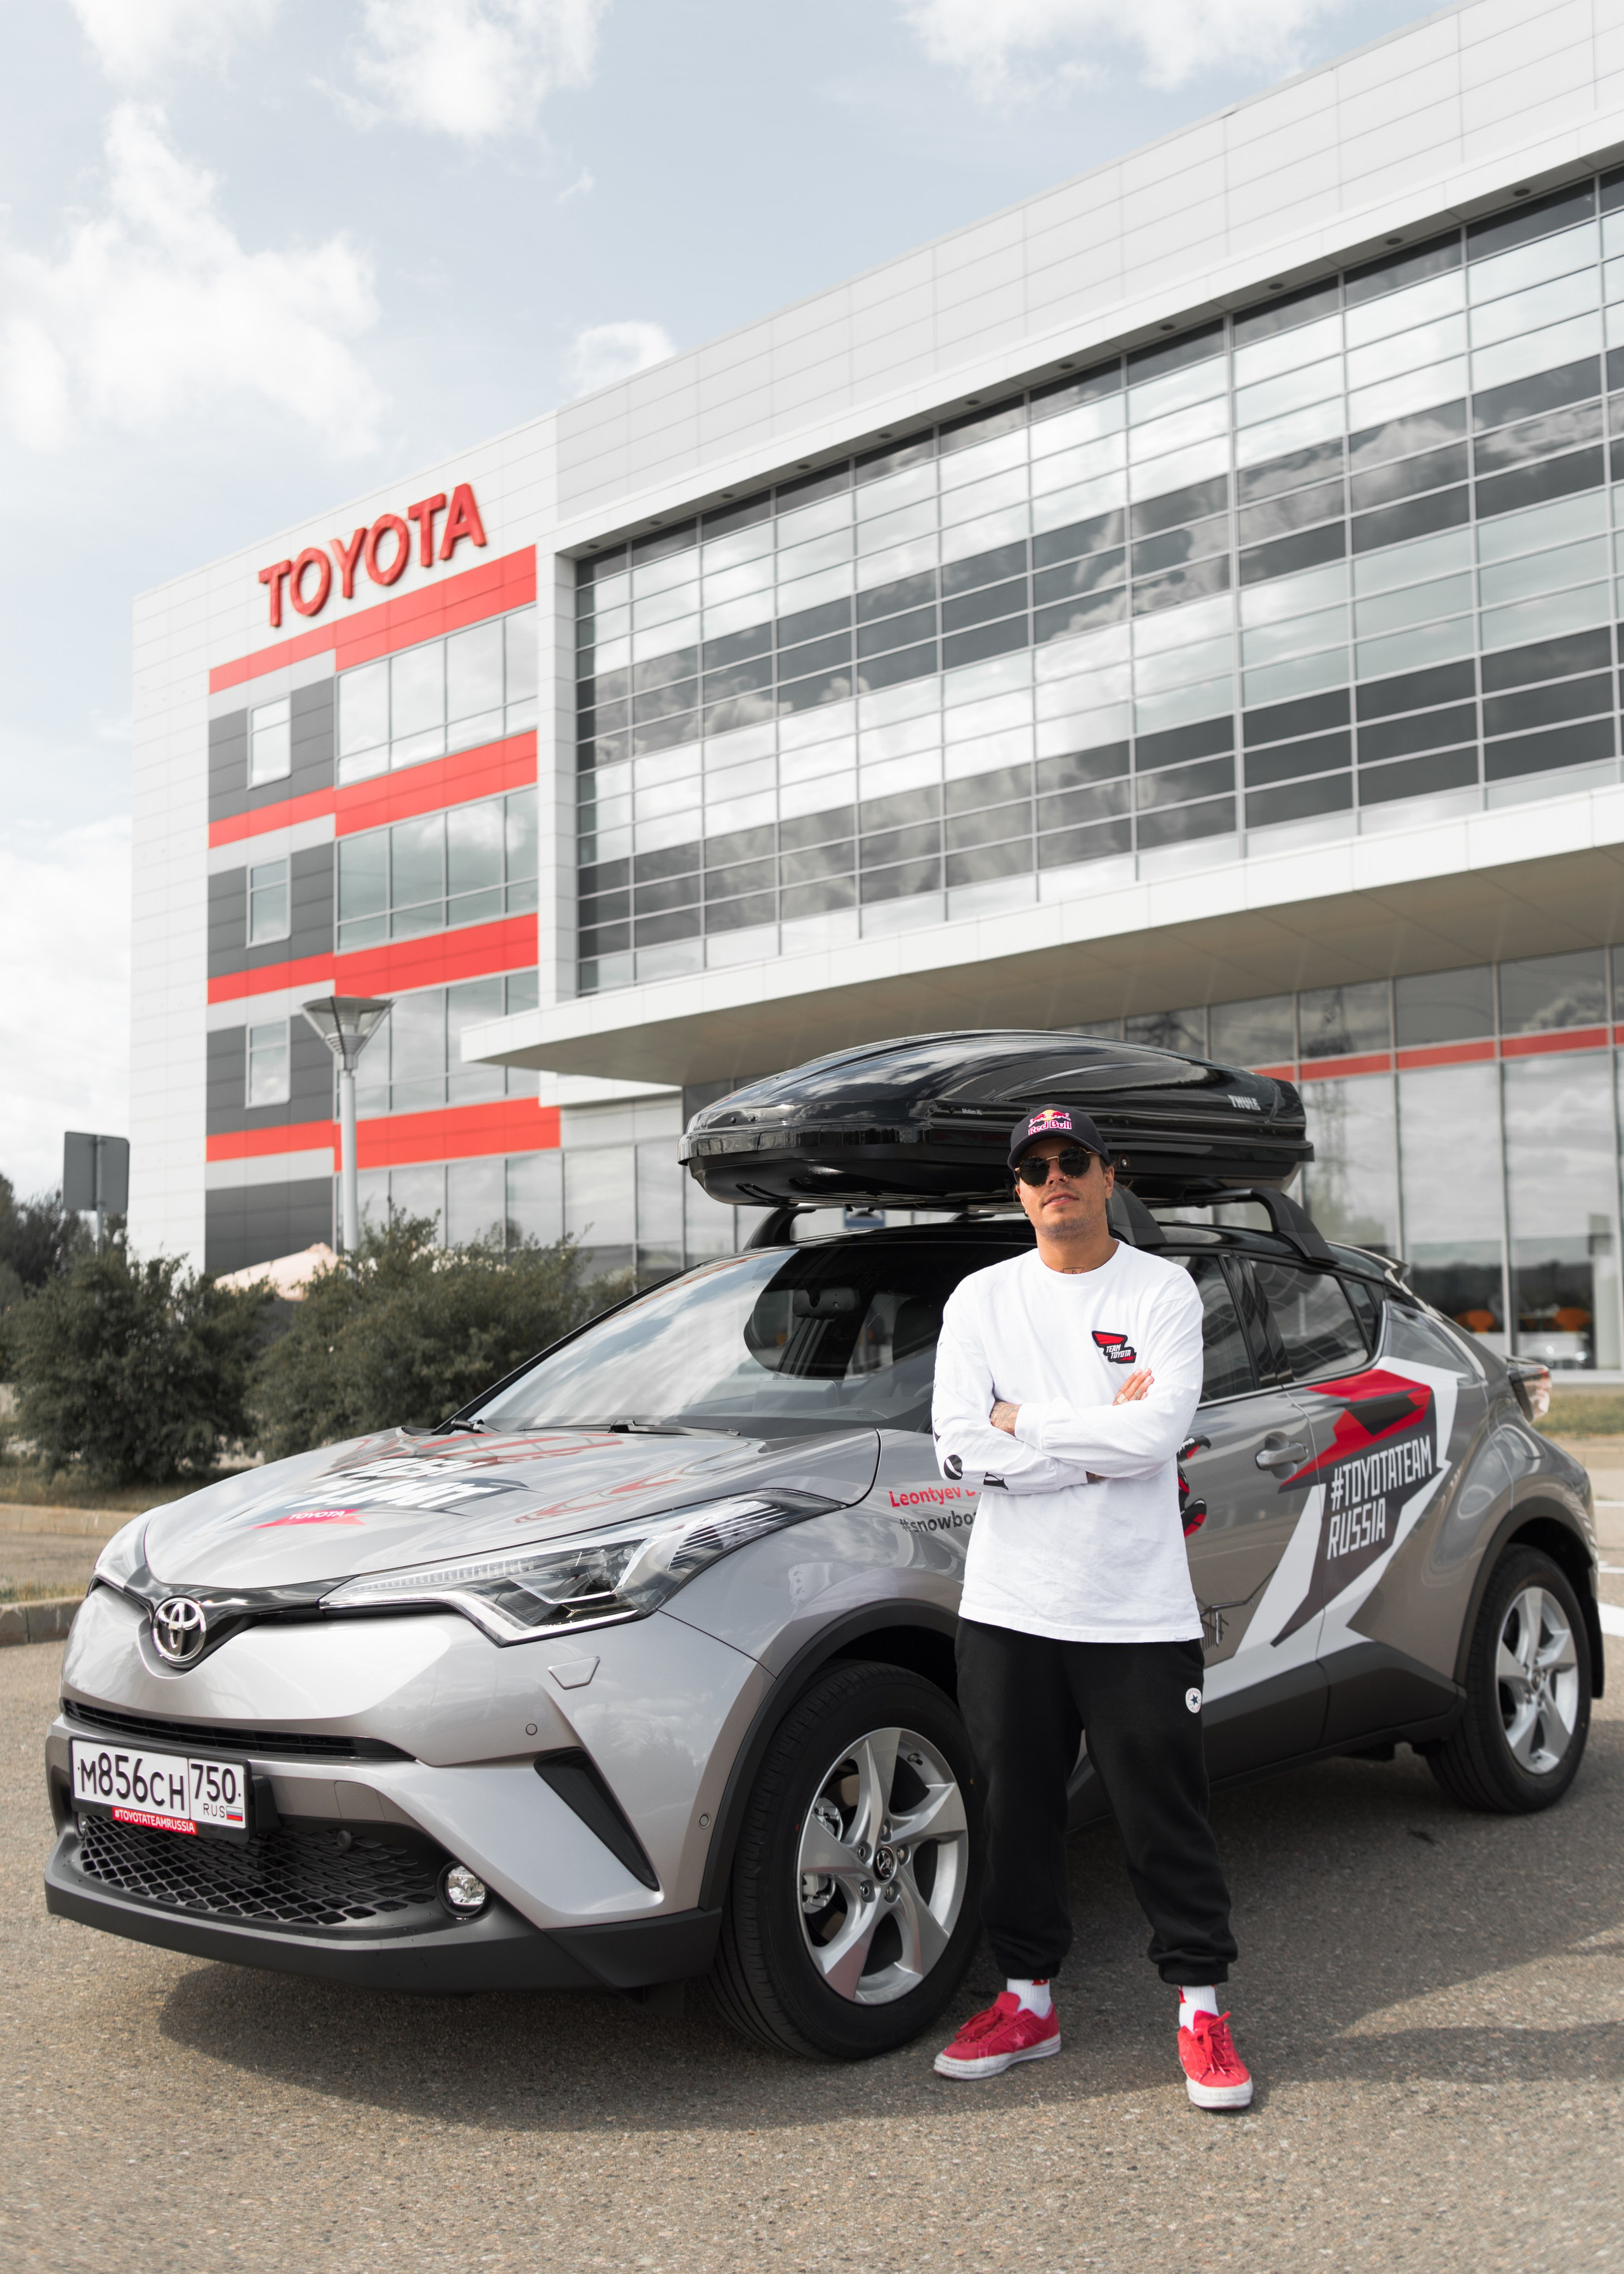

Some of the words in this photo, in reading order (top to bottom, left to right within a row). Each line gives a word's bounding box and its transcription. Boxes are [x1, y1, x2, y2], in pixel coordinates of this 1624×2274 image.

[259, 483, 488, 628] TOYOTA
[1228, 1094, 1261, 1111] THULE
[1028, 1121, 1049, 1136] Red
[1049, 1120, 1072, 1129] Bull
[1106, 1344, 1121, 1353] TEAM
[1110, 1349, 1132, 1359] TOYOTA
[1331, 1435, 1432, 1512] #TOYOTATEAM
[284, 1479, 502, 1508] LIMIT
[889, 1487, 961, 1508] Leontyev
[288, 1510, 346, 1520] TOYOTA
[900, 1510, 976, 1532] #snowbo
[1327, 1497, 1386, 1560] RUSSIA
[190, 1763, 237, 1804] 750
[114, 1808, 195, 1833] #TOYOTATEAMRUSSIA
[203, 1803, 226, 1818] RUS
